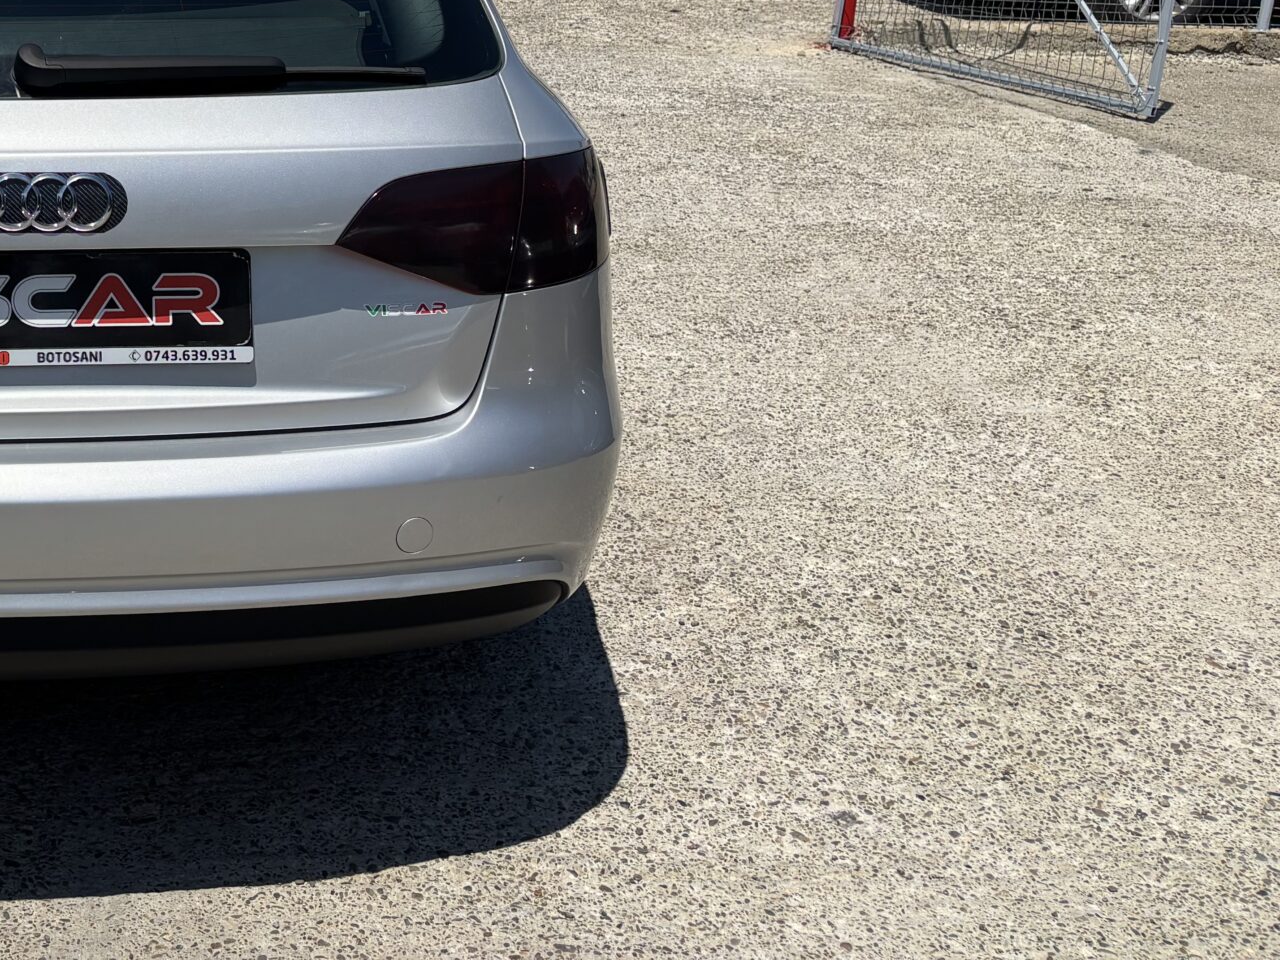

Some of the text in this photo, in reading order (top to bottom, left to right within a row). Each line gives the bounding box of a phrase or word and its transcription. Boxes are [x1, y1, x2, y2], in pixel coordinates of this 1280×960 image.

[364, 302, 448, 317] VISCAR
[37, 351, 103, 363] BOTOSANI
[144, 349, 237, 362] 0743.639.931
